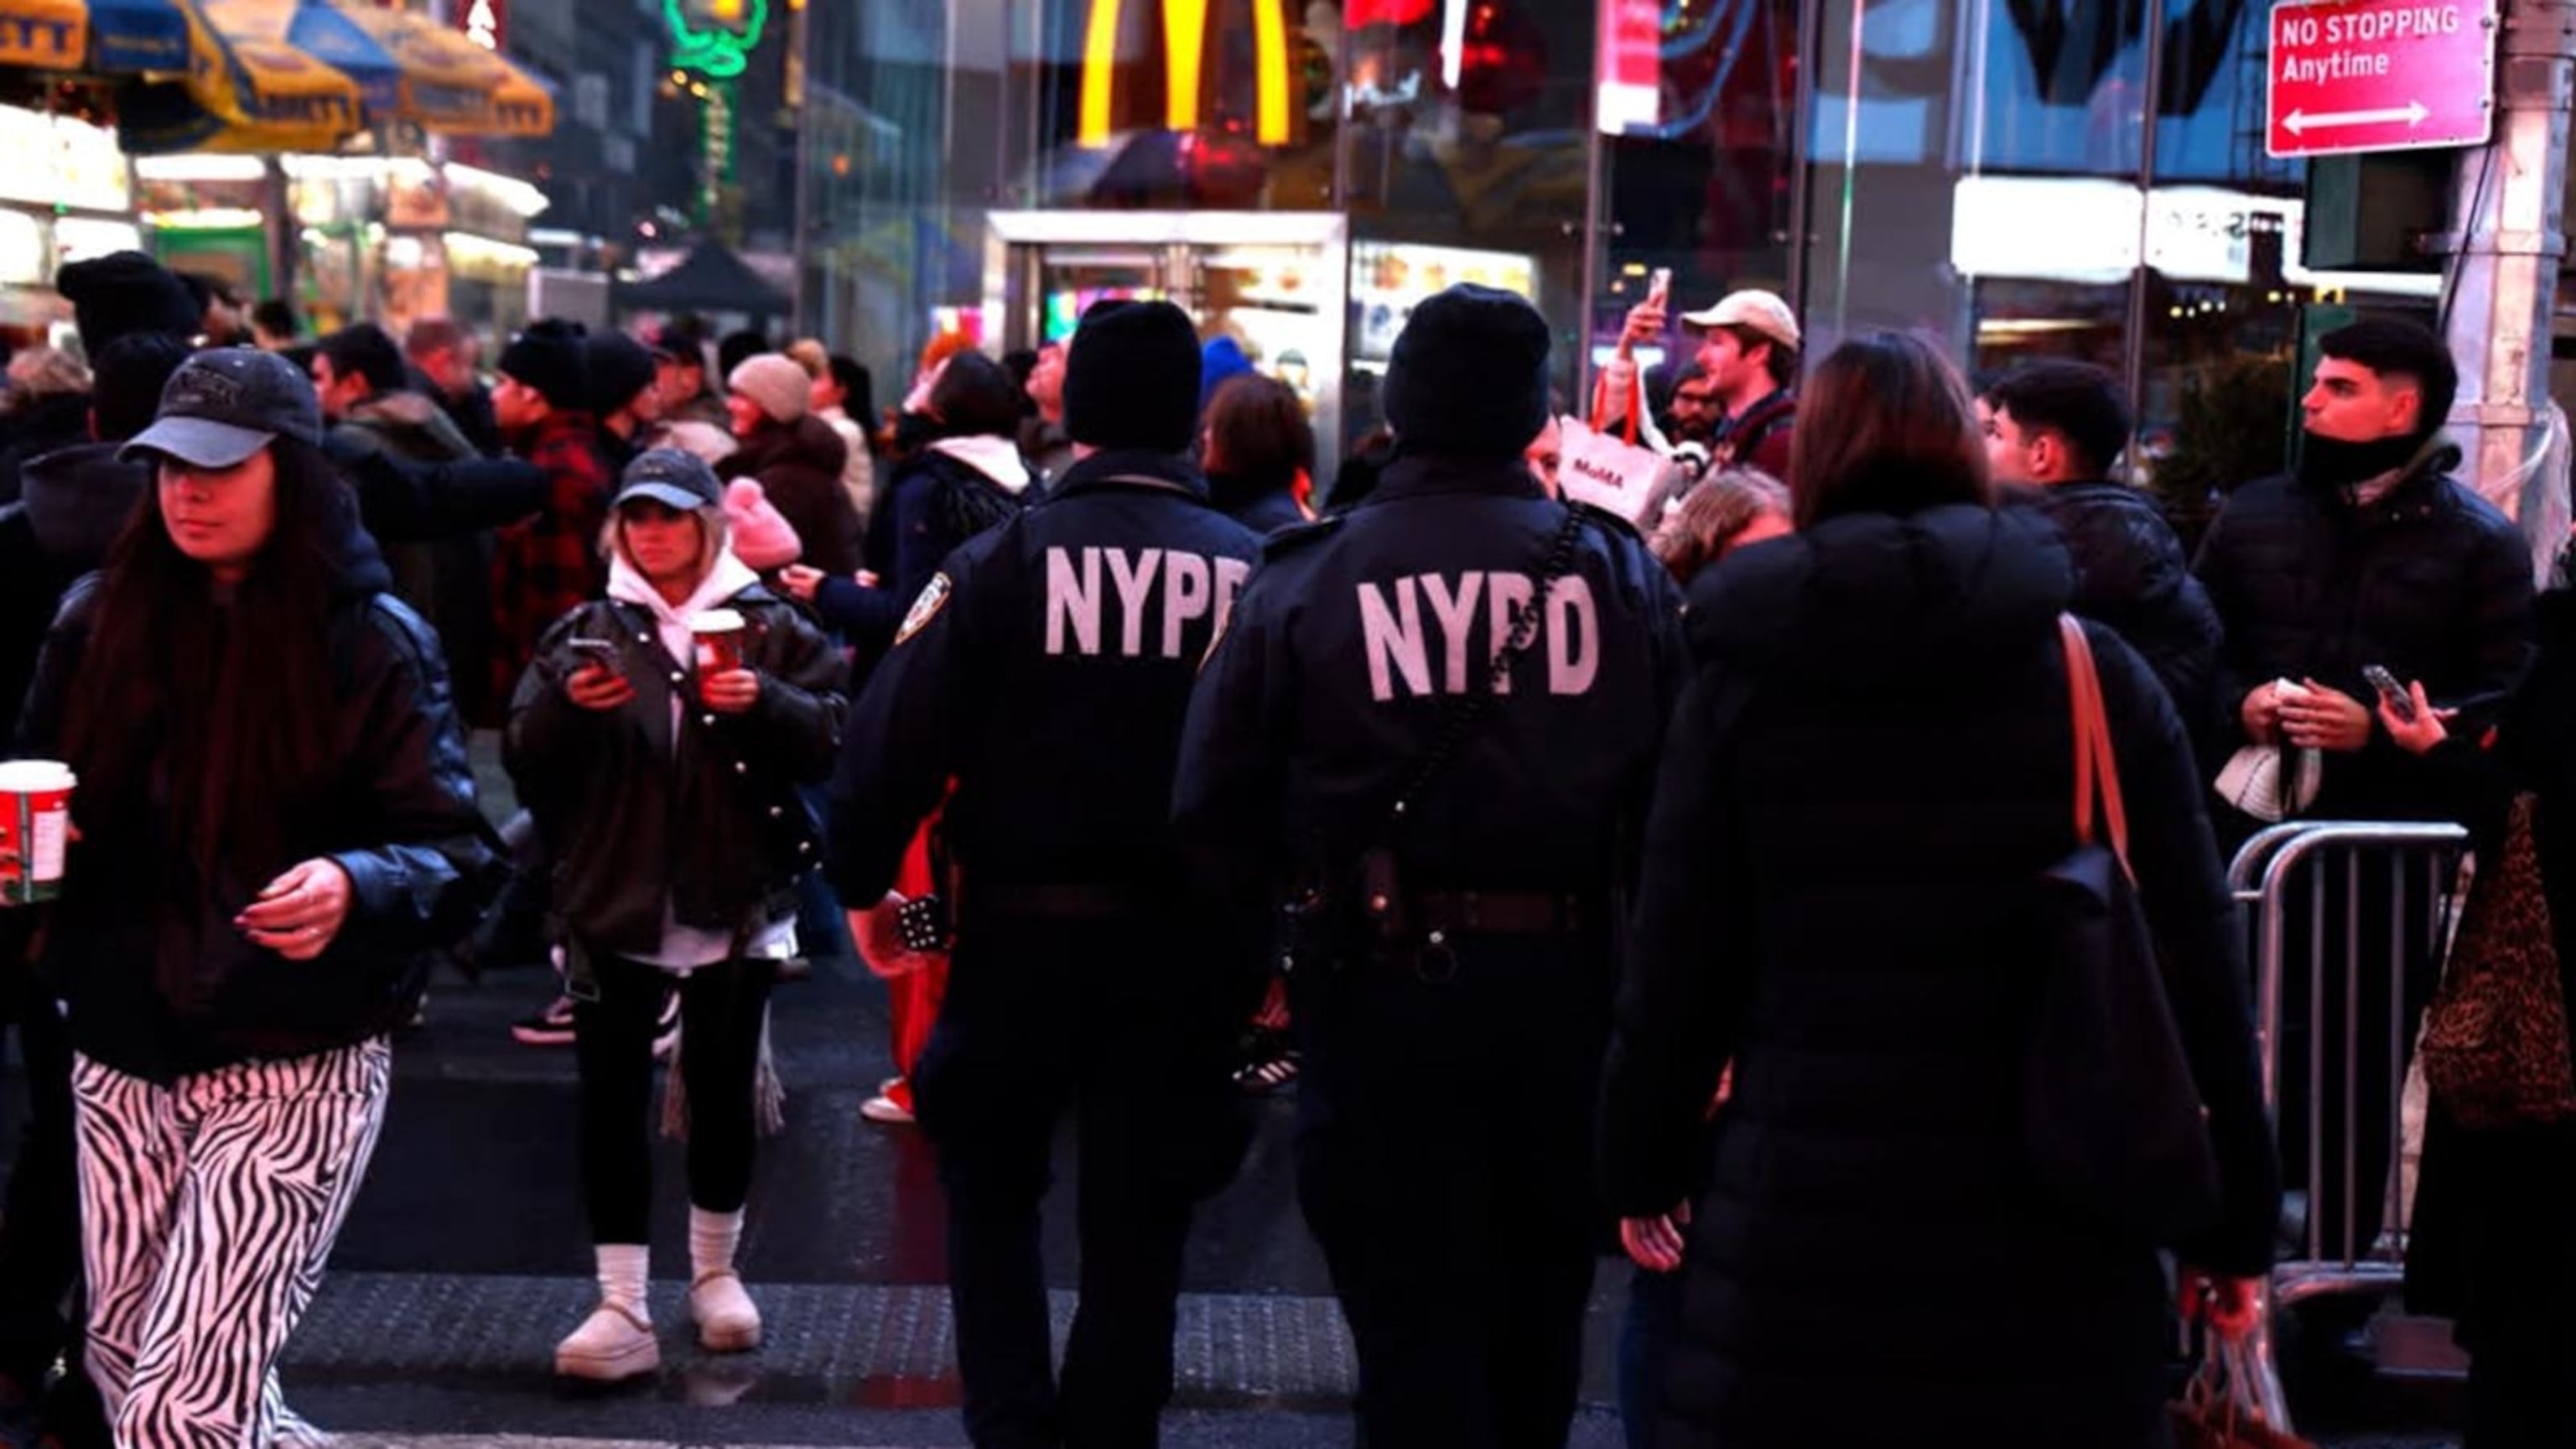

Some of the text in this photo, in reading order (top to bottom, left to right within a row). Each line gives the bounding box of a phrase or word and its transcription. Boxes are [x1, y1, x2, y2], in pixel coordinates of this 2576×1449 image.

[2281, 5, 2459, 47] NO STOPPING
[2281, 50, 2389, 86] Anytime
[1357, 570, 1599, 701] NYPD
